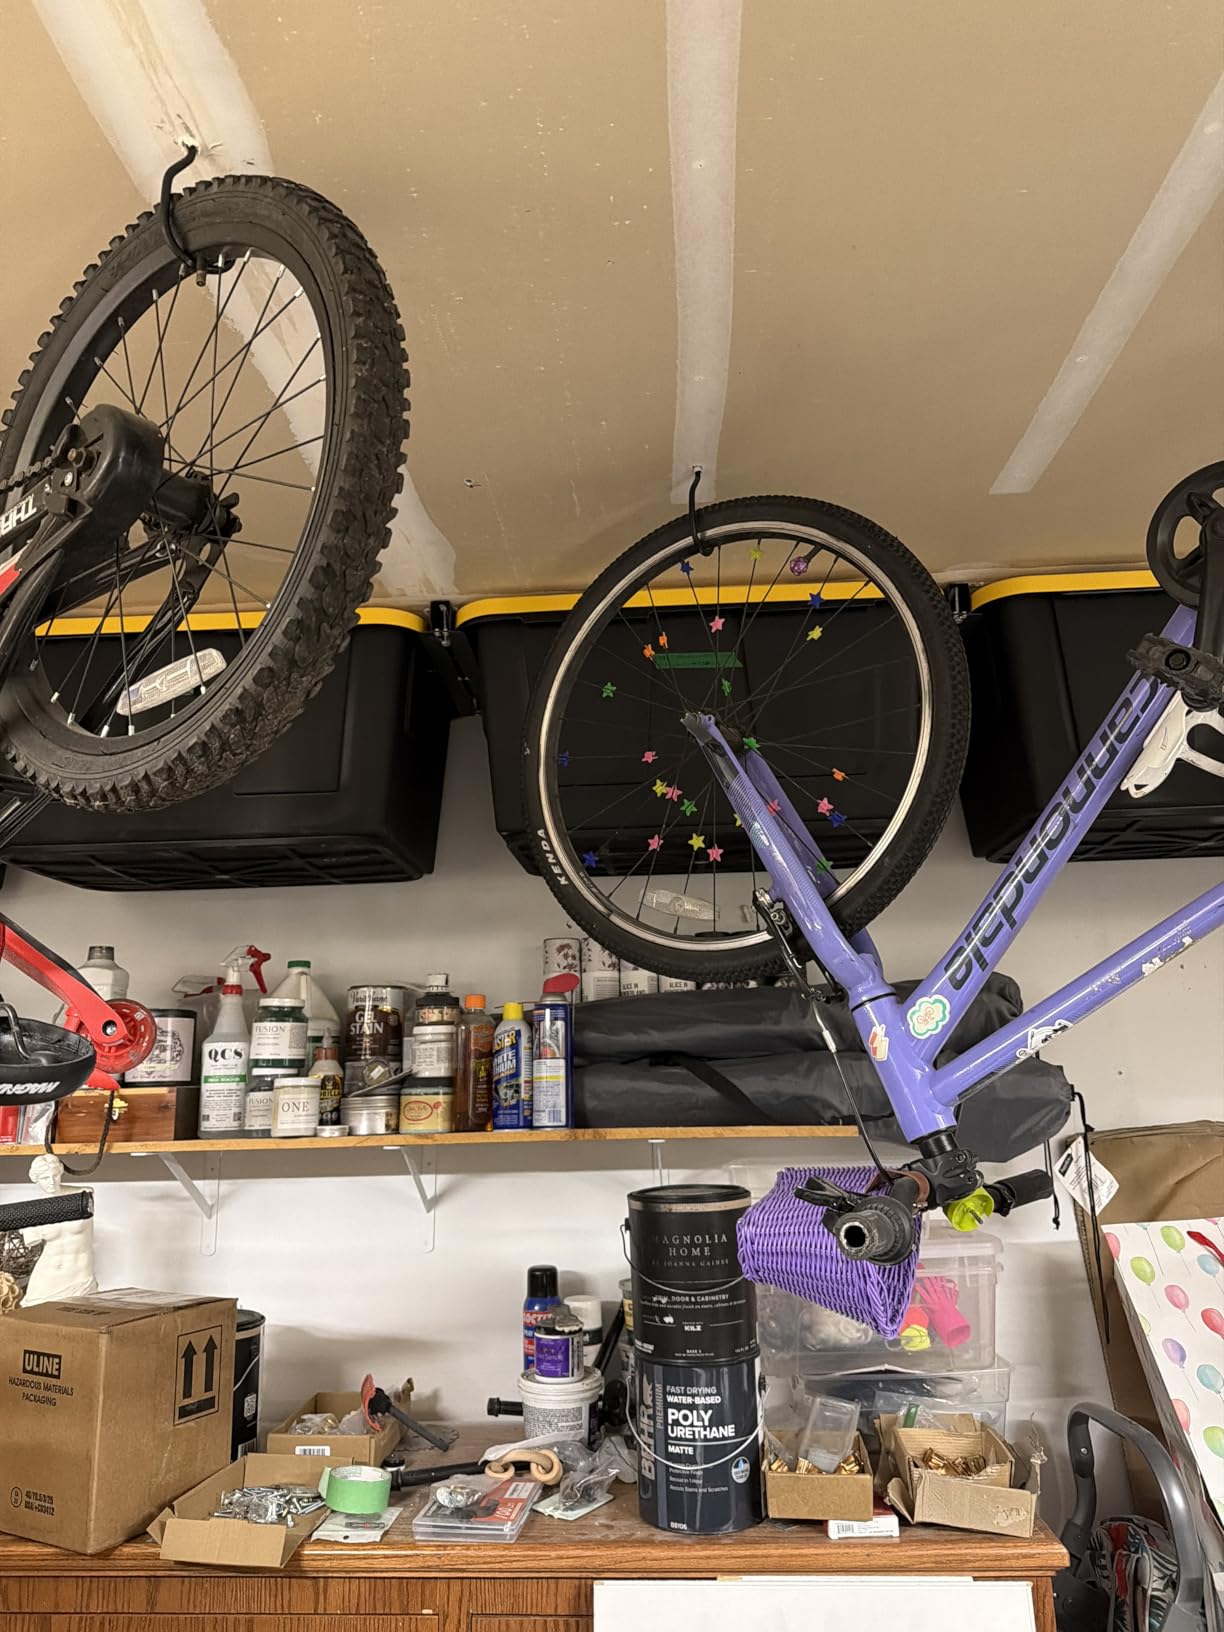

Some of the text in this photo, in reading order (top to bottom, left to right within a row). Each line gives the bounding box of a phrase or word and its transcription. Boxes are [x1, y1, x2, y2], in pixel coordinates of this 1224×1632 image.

[0, 492, 37, 538] THR
[537, 828, 569, 885] KENDA
[355, 1011, 377, 1023] GEL
[350, 1022, 384, 1035] STAIN
[208, 1048, 243, 1062] QCS
[281, 1101, 310, 1112] ONE
[655, 1233, 728, 1244] AGNOLIA
[669, 1246, 710, 1256] HOME
[25, 1353, 60, 1376] ULINE
[8, 1376, 74, 1396] HAZARDOUS MATERIALS
[666, 1385, 716, 1394] FAST DRYING
[22, 1392, 57, 1406] PACKAGING
[666, 1394, 721, 1404] WATER-BASED
[656, 1384, 664, 1430] PREMIUM
[668, 1408, 712, 1426] POLY
[668, 1424, 735, 1439] URETHANE
[668, 1445, 694, 1455] MATTE
